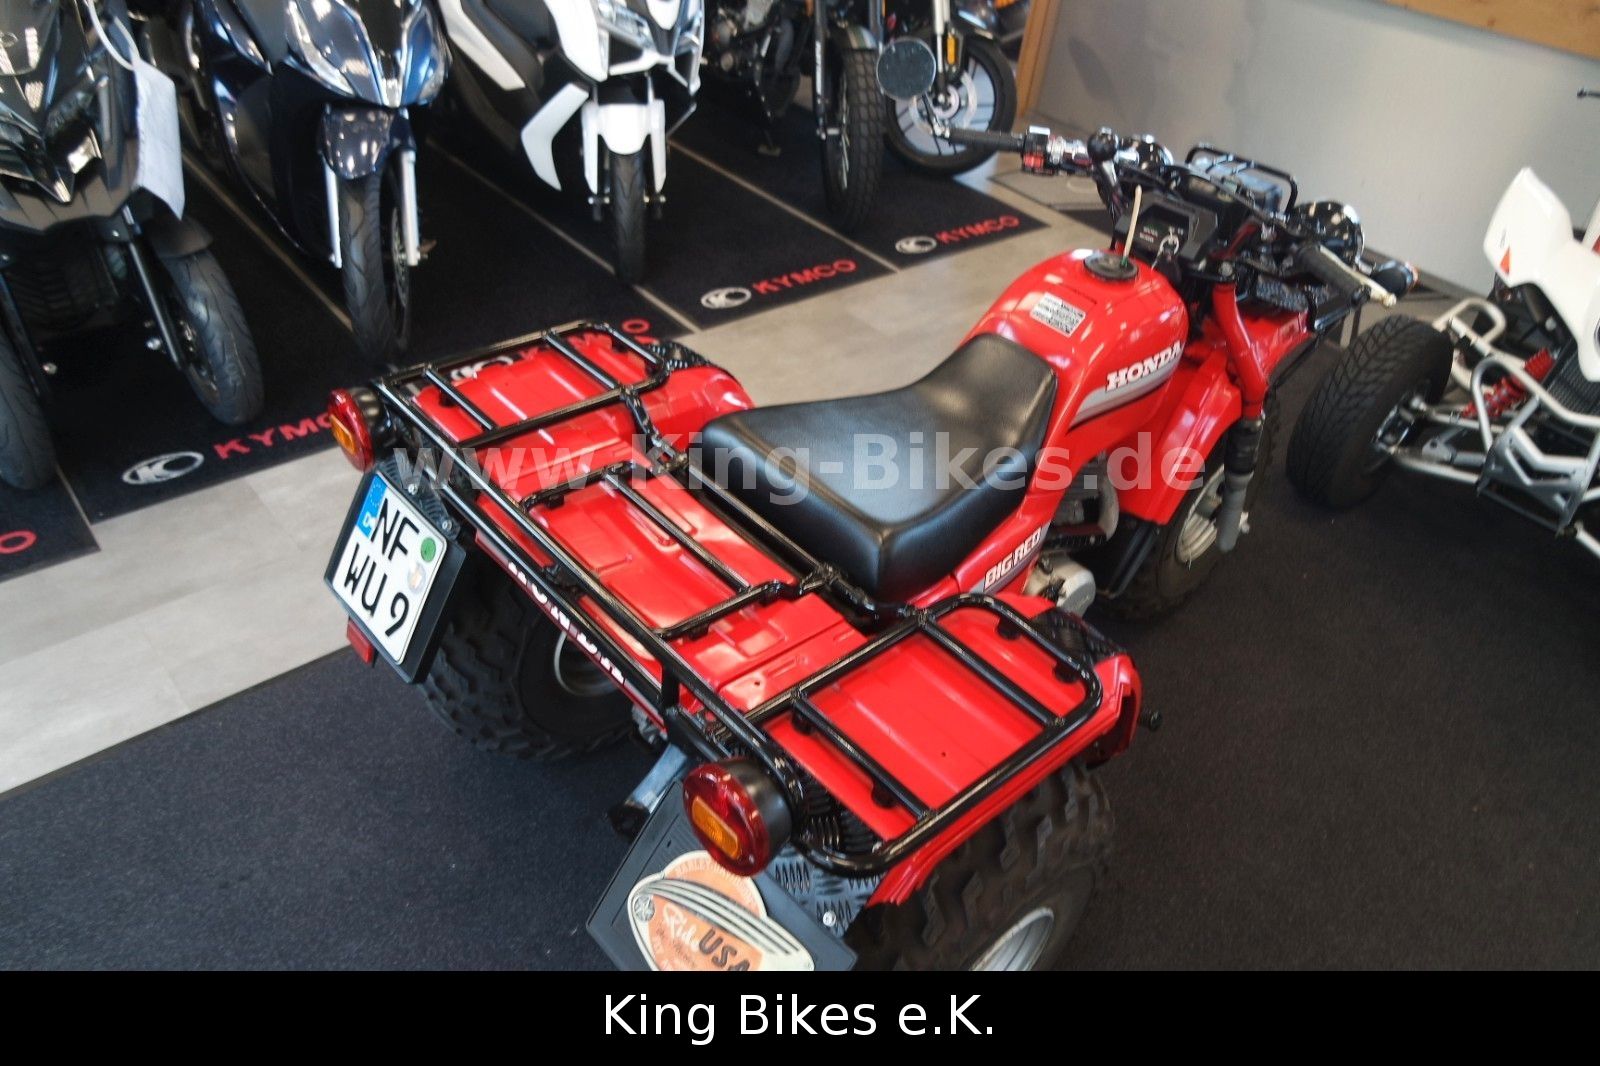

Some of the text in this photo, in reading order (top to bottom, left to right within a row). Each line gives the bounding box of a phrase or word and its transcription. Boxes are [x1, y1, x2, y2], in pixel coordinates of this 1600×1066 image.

[935, 215, 1019, 244] KYMCO
[752, 259, 856, 295] KYMCO
[1105, 340, 1182, 392] HONDA
[213, 411, 331, 460] KYMC
[370, 498, 420, 561] NF
[343, 543, 410, 638] WU 9
[984, 551, 1013, 590] BIG
